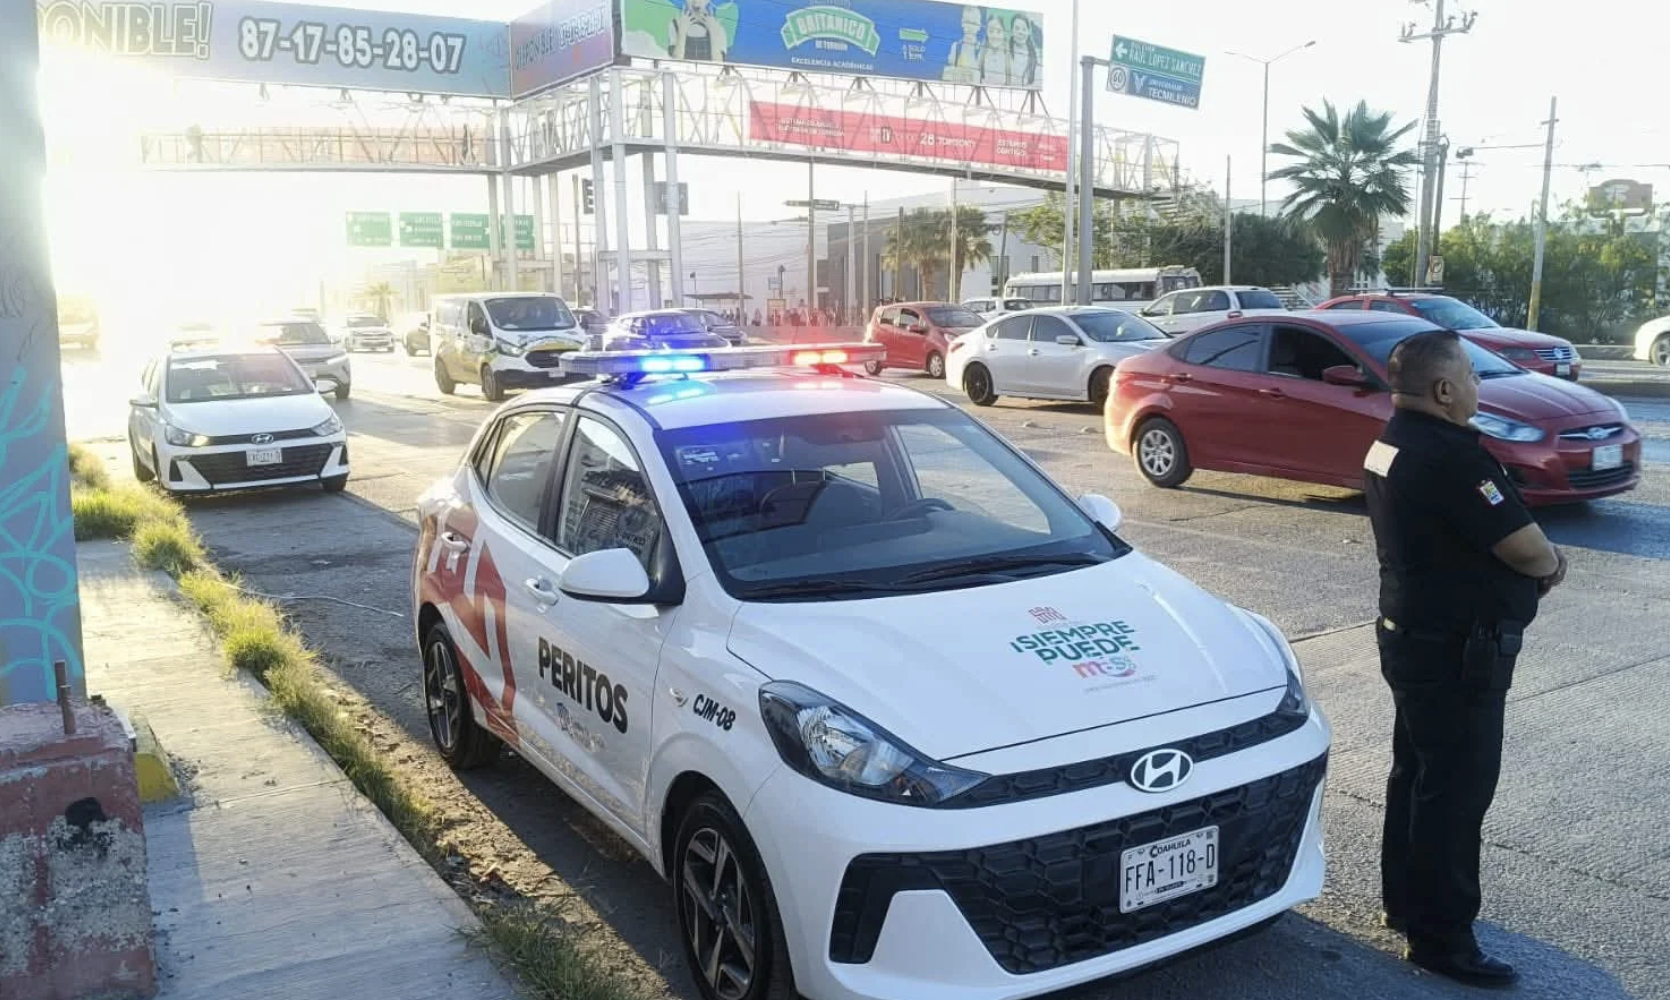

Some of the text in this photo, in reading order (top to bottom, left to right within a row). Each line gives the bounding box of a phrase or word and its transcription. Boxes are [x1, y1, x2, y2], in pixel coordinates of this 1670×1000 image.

[239, 17, 466, 73] 87-17-85-28-07
[538, 636, 628, 734] PERITOS
[693, 694, 736, 731] CJM-08
[1125, 844, 1215, 894] FFA-118-D
